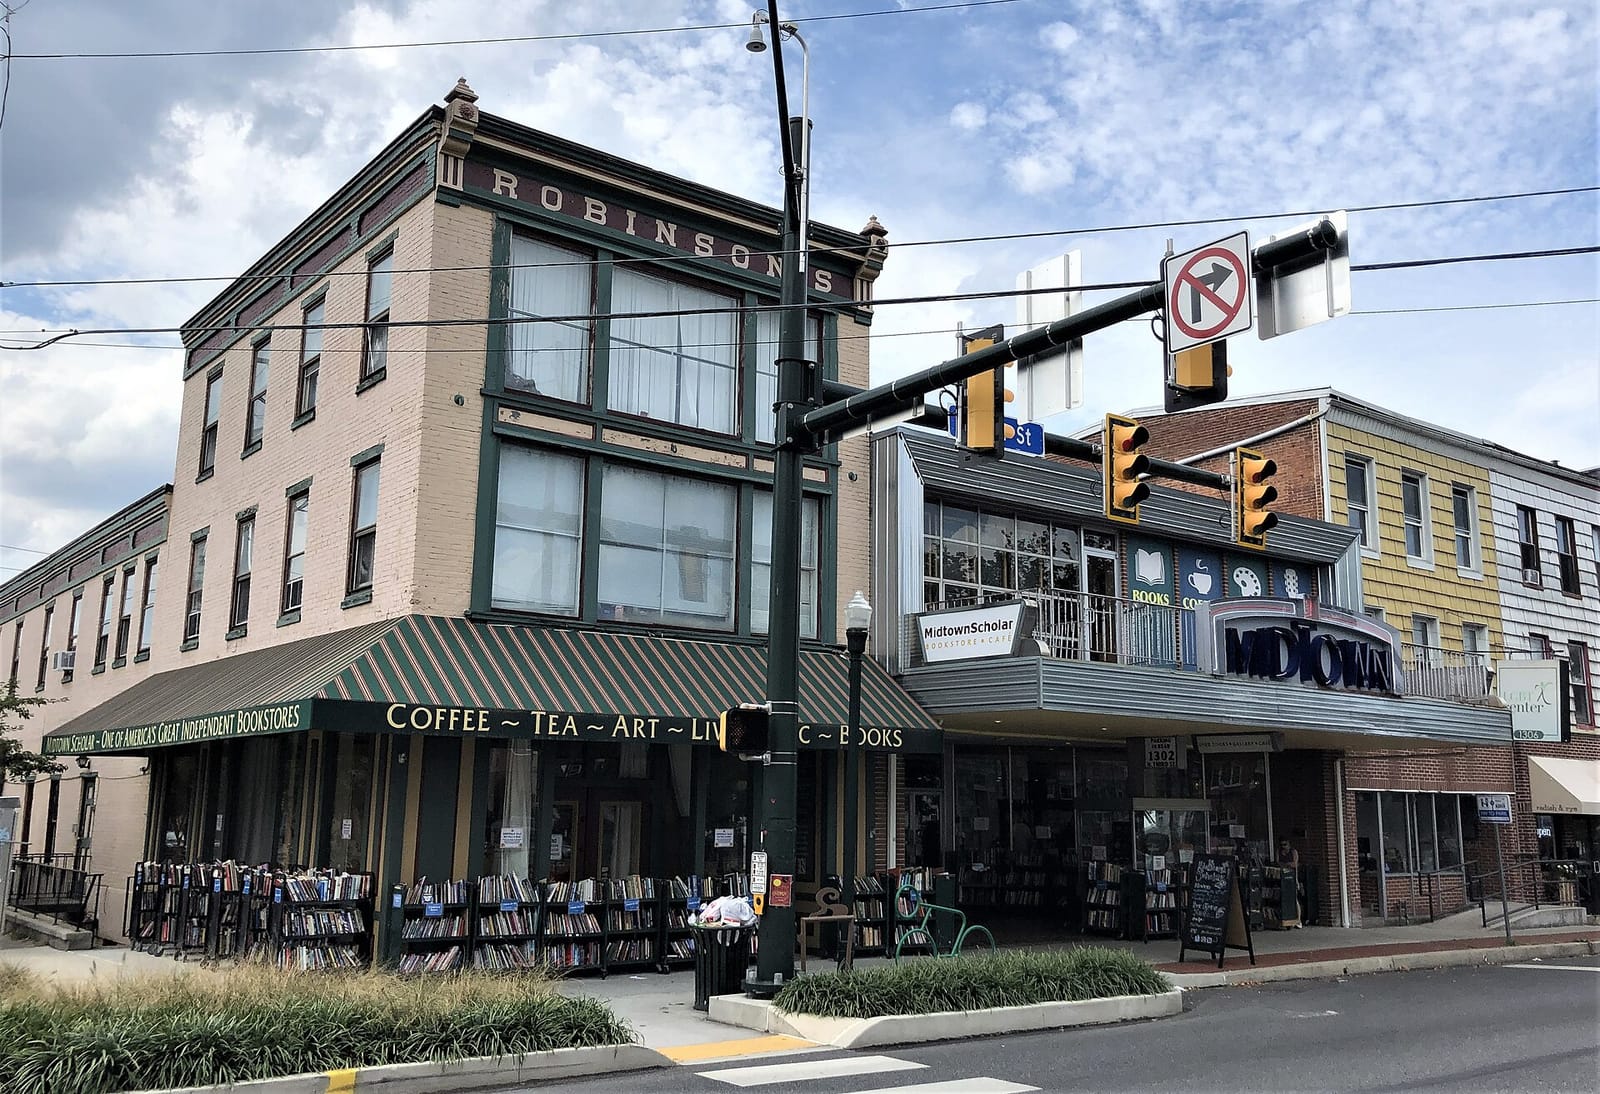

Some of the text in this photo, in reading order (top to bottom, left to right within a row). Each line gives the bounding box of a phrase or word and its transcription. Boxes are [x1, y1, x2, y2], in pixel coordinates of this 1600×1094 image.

[1016, 426, 1032, 447] St
[1132, 589, 1170, 606] BOOKS
[924, 619, 1014, 639] MidtownScholar
[925, 638, 977, 650] BOOKSTORE
[1225, 620, 1393, 692] MIDTOWN
[1507, 702, 1545, 713] enter
[70, 734, 95, 752] SCHOLAR
[101, 730, 115, 749] ONE
[114, 731, 124, 748] OF
[158, 722, 180, 743] GREAT
[181, 713, 235, 740] INDEPENDENT
[237, 704, 300, 734] BOOKSTORES
[386, 703, 490, 732] COFFEE
[530, 710, 579, 736] TEA
[611, 714, 660, 739] ART
[691, 718, 721, 741] LIV
[839, 725, 903, 748] BOOKS
[1519, 730, 1539, 739] 1306
[1148, 750, 1175, 761] 1302
